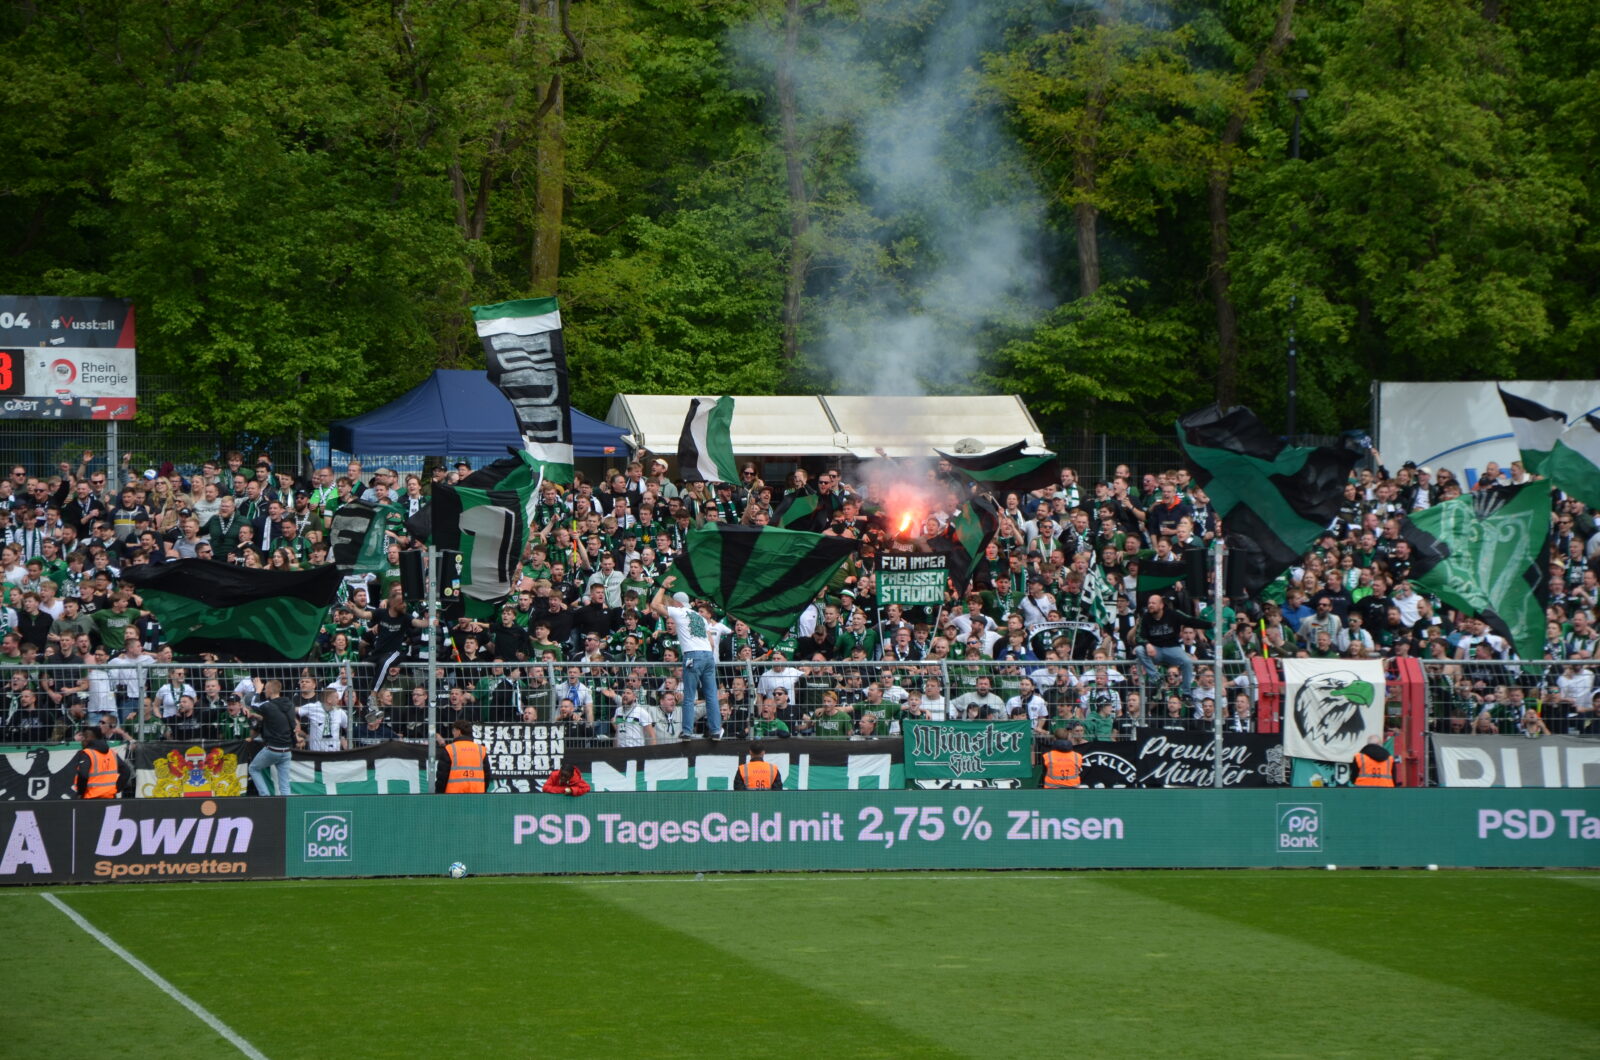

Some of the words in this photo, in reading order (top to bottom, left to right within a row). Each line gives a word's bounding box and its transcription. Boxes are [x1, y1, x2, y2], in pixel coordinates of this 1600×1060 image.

[0, 312, 31, 328] 04
[81, 362, 116, 373] Rhein
[81, 373, 128, 385] Energie
[4, 401, 39, 411] GAST
[910, 556, 946, 570] IMMER
[881, 572, 945, 585] PREUSSEN
[881, 586, 945, 603] STADION
[471, 724, 565, 740] SEKTION
[911, 723, 1025, 760] Münster
[487, 755, 564, 771] ERBOT
[949, 754, 986, 777] Süd
[462, 770, 475, 778] 49
[1337, 764, 1348, 780] P
[32, 779, 46, 797] P
[95, 800, 254, 856] bwin
[513, 814, 591, 845] PSD
[597, 812, 782, 850] TagesGeld
[788, 812, 844, 841] mit
[858, 806, 945, 848] 2,75
[952, 806, 993, 840] %
[1006, 810, 1124, 840] Zinsen
[1288, 815, 1319, 833] psd
[1477, 809, 1556, 840] PSD
[317, 824, 348, 841] psd
[1280, 834, 1319, 848] Bank
[308, 843, 348, 857] Bank
[94, 860, 247, 878] Sportwetten
